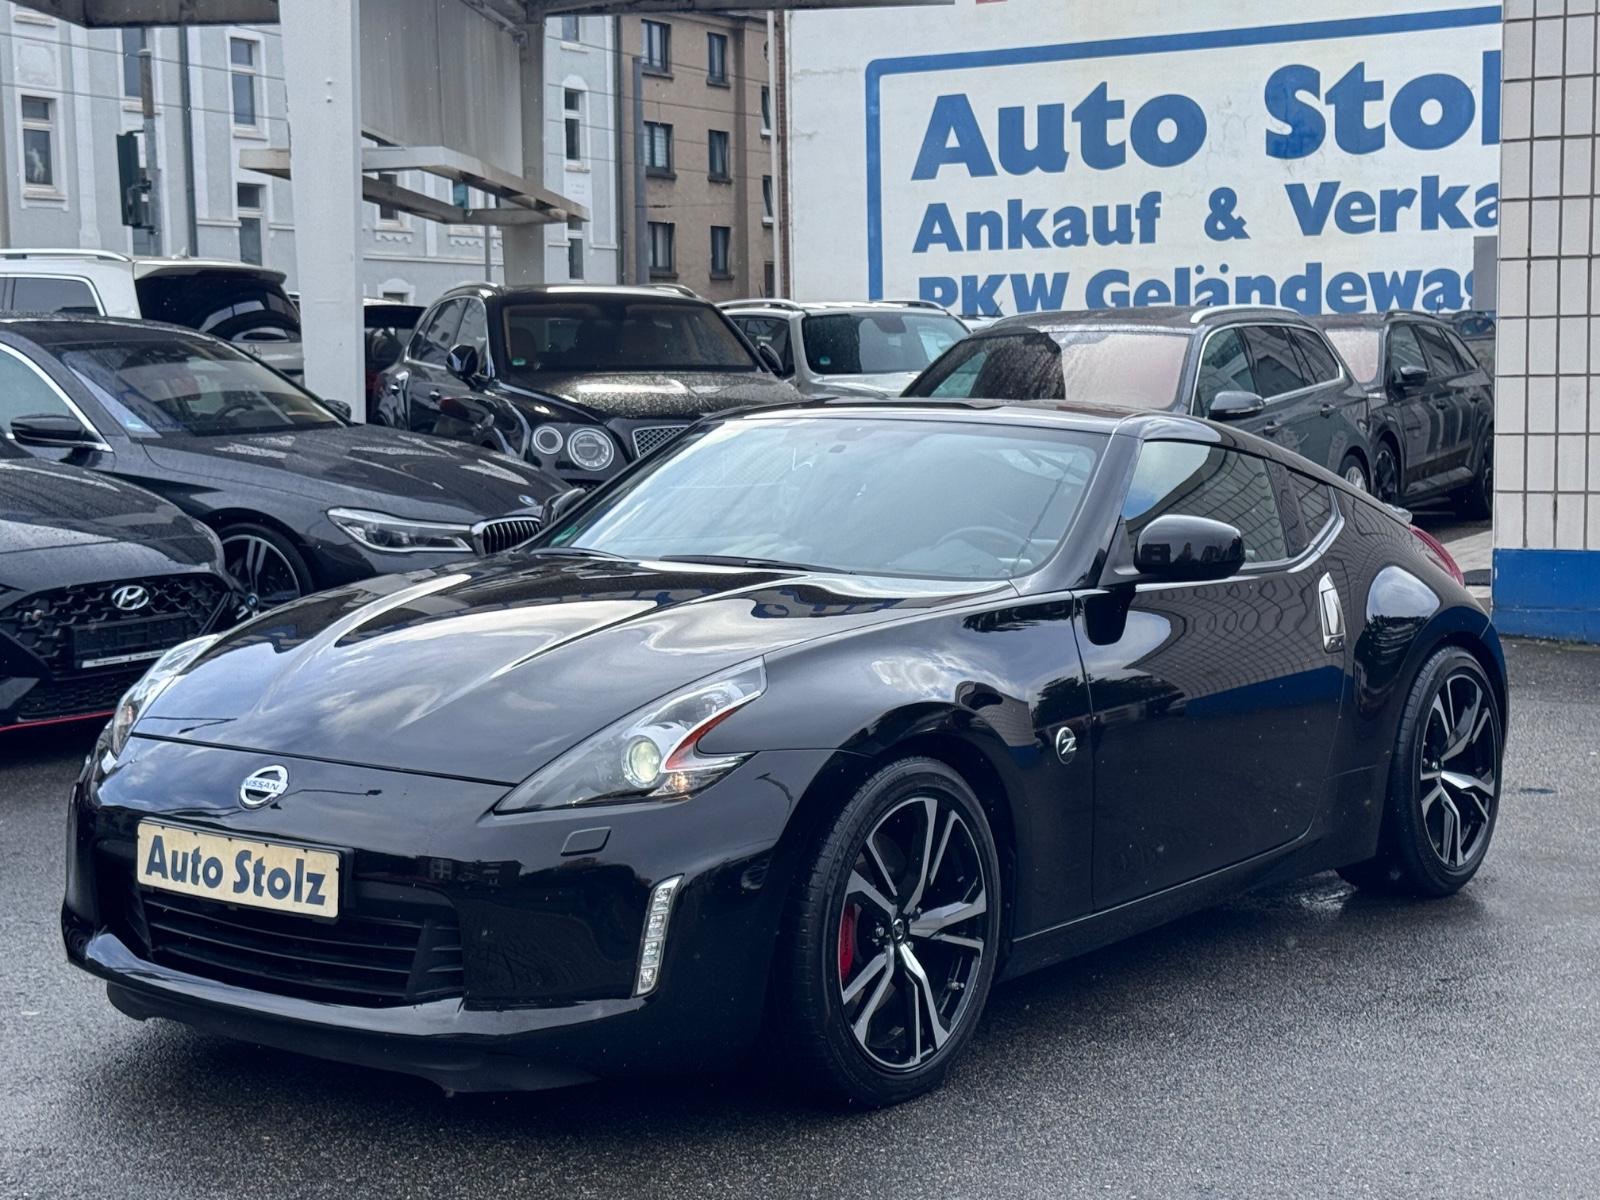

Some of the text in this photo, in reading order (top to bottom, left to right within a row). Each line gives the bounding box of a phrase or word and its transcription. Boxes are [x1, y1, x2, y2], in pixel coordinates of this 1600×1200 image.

[911, 82, 1207, 181] Auto
[912, 191, 1161, 253] Ankauf
[1204, 186, 1251, 242] &
[918, 262, 1475, 317] PKW Geländewa
[245, 779, 280, 791] NISSAN
[145, 834, 326, 906] Auto Stolz
